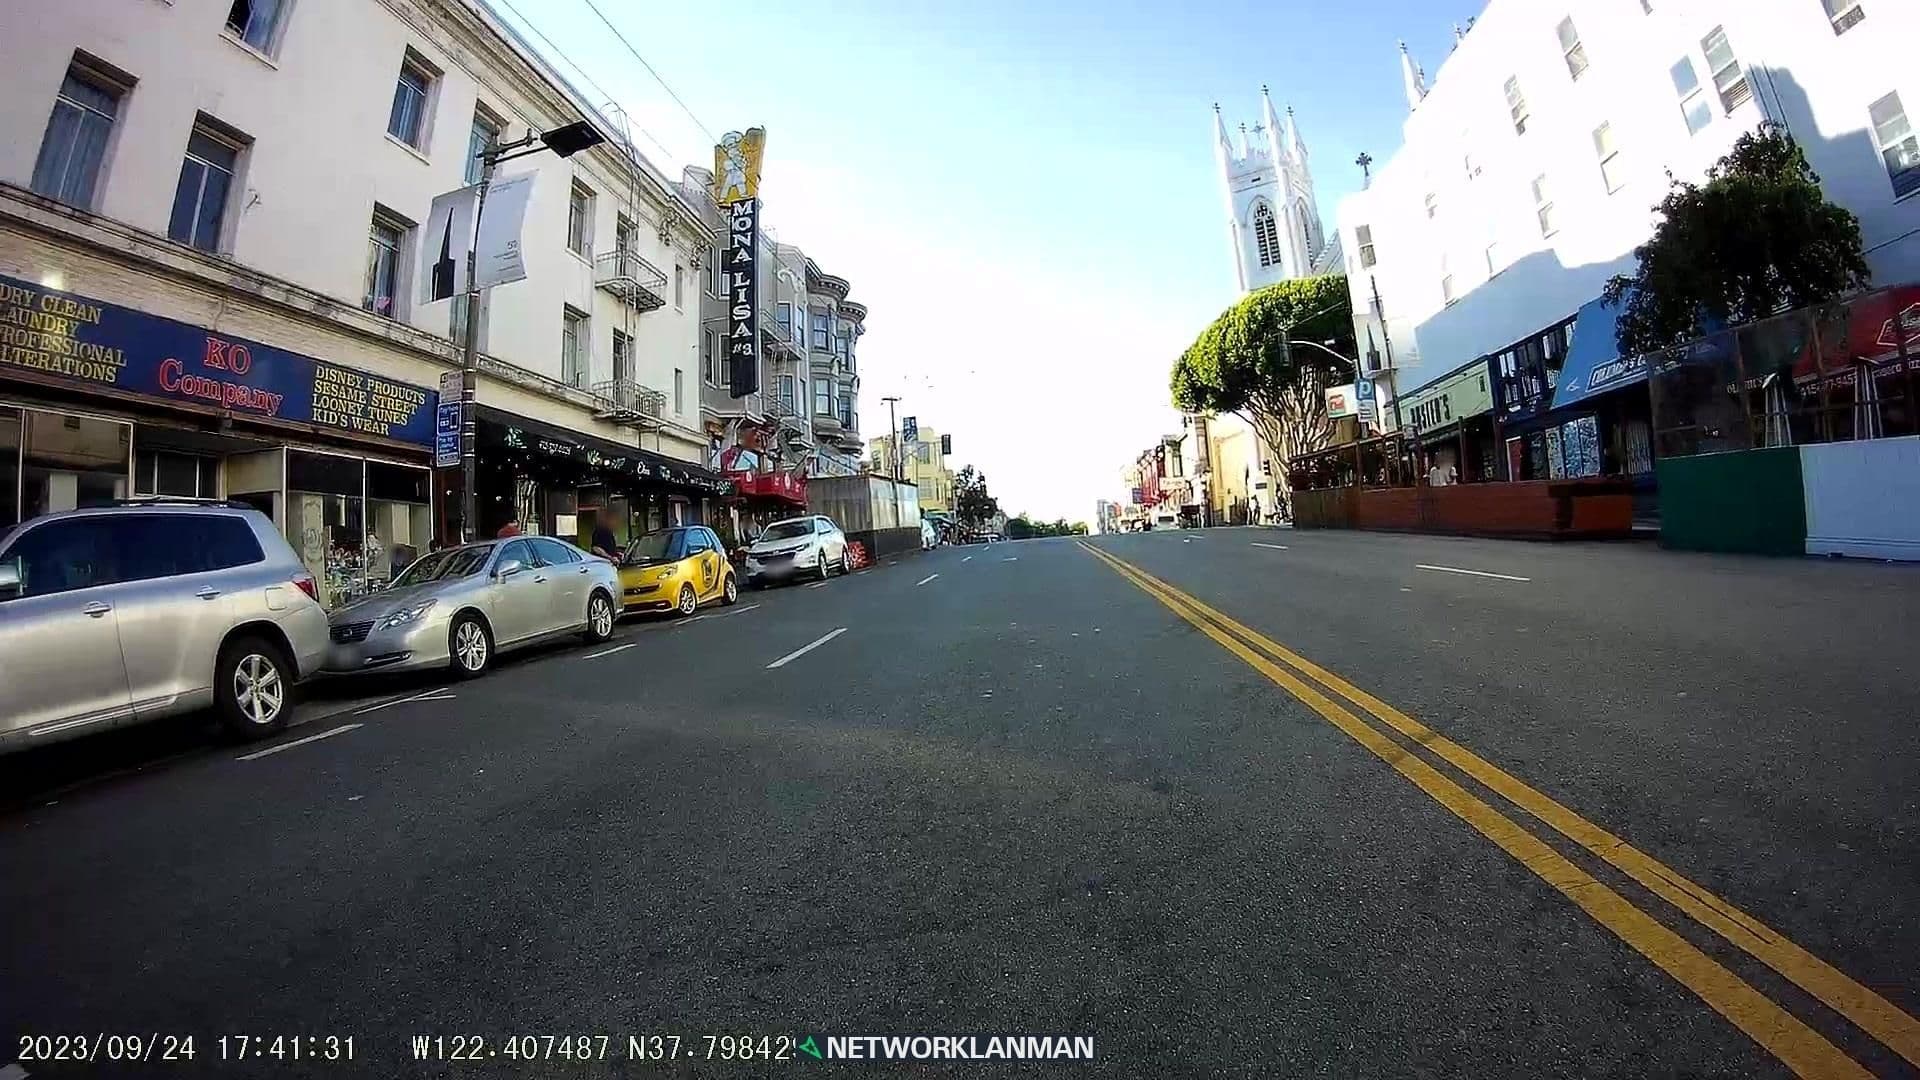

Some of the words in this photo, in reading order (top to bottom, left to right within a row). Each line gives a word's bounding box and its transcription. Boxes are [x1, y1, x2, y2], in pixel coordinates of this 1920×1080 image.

[731, 200, 754, 263] MONA
[0, 283, 36, 307] DRY
[41, 294, 103, 324] CLEAN
[731, 272, 752, 338] LISA
[0, 324, 127, 367] ROFESSIONAL
[0, 344, 117, 383] LTERATIONS
[204, 337, 251, 375] KO
[160, 358, 283, 416] Company
[314, 379, 367, 404] SESAME
[371, 393, 418, 415] STREET
[316, 365, 364, 388] DISNEY
[367, 378, 425, 405] PRODUCTS
[312, 393, 364, 417] LOONEY
[367, 406, 409, 426] TUNES
[312, 407, 348, 427] KID'S
[351, 416, 390, 436] WEAR
